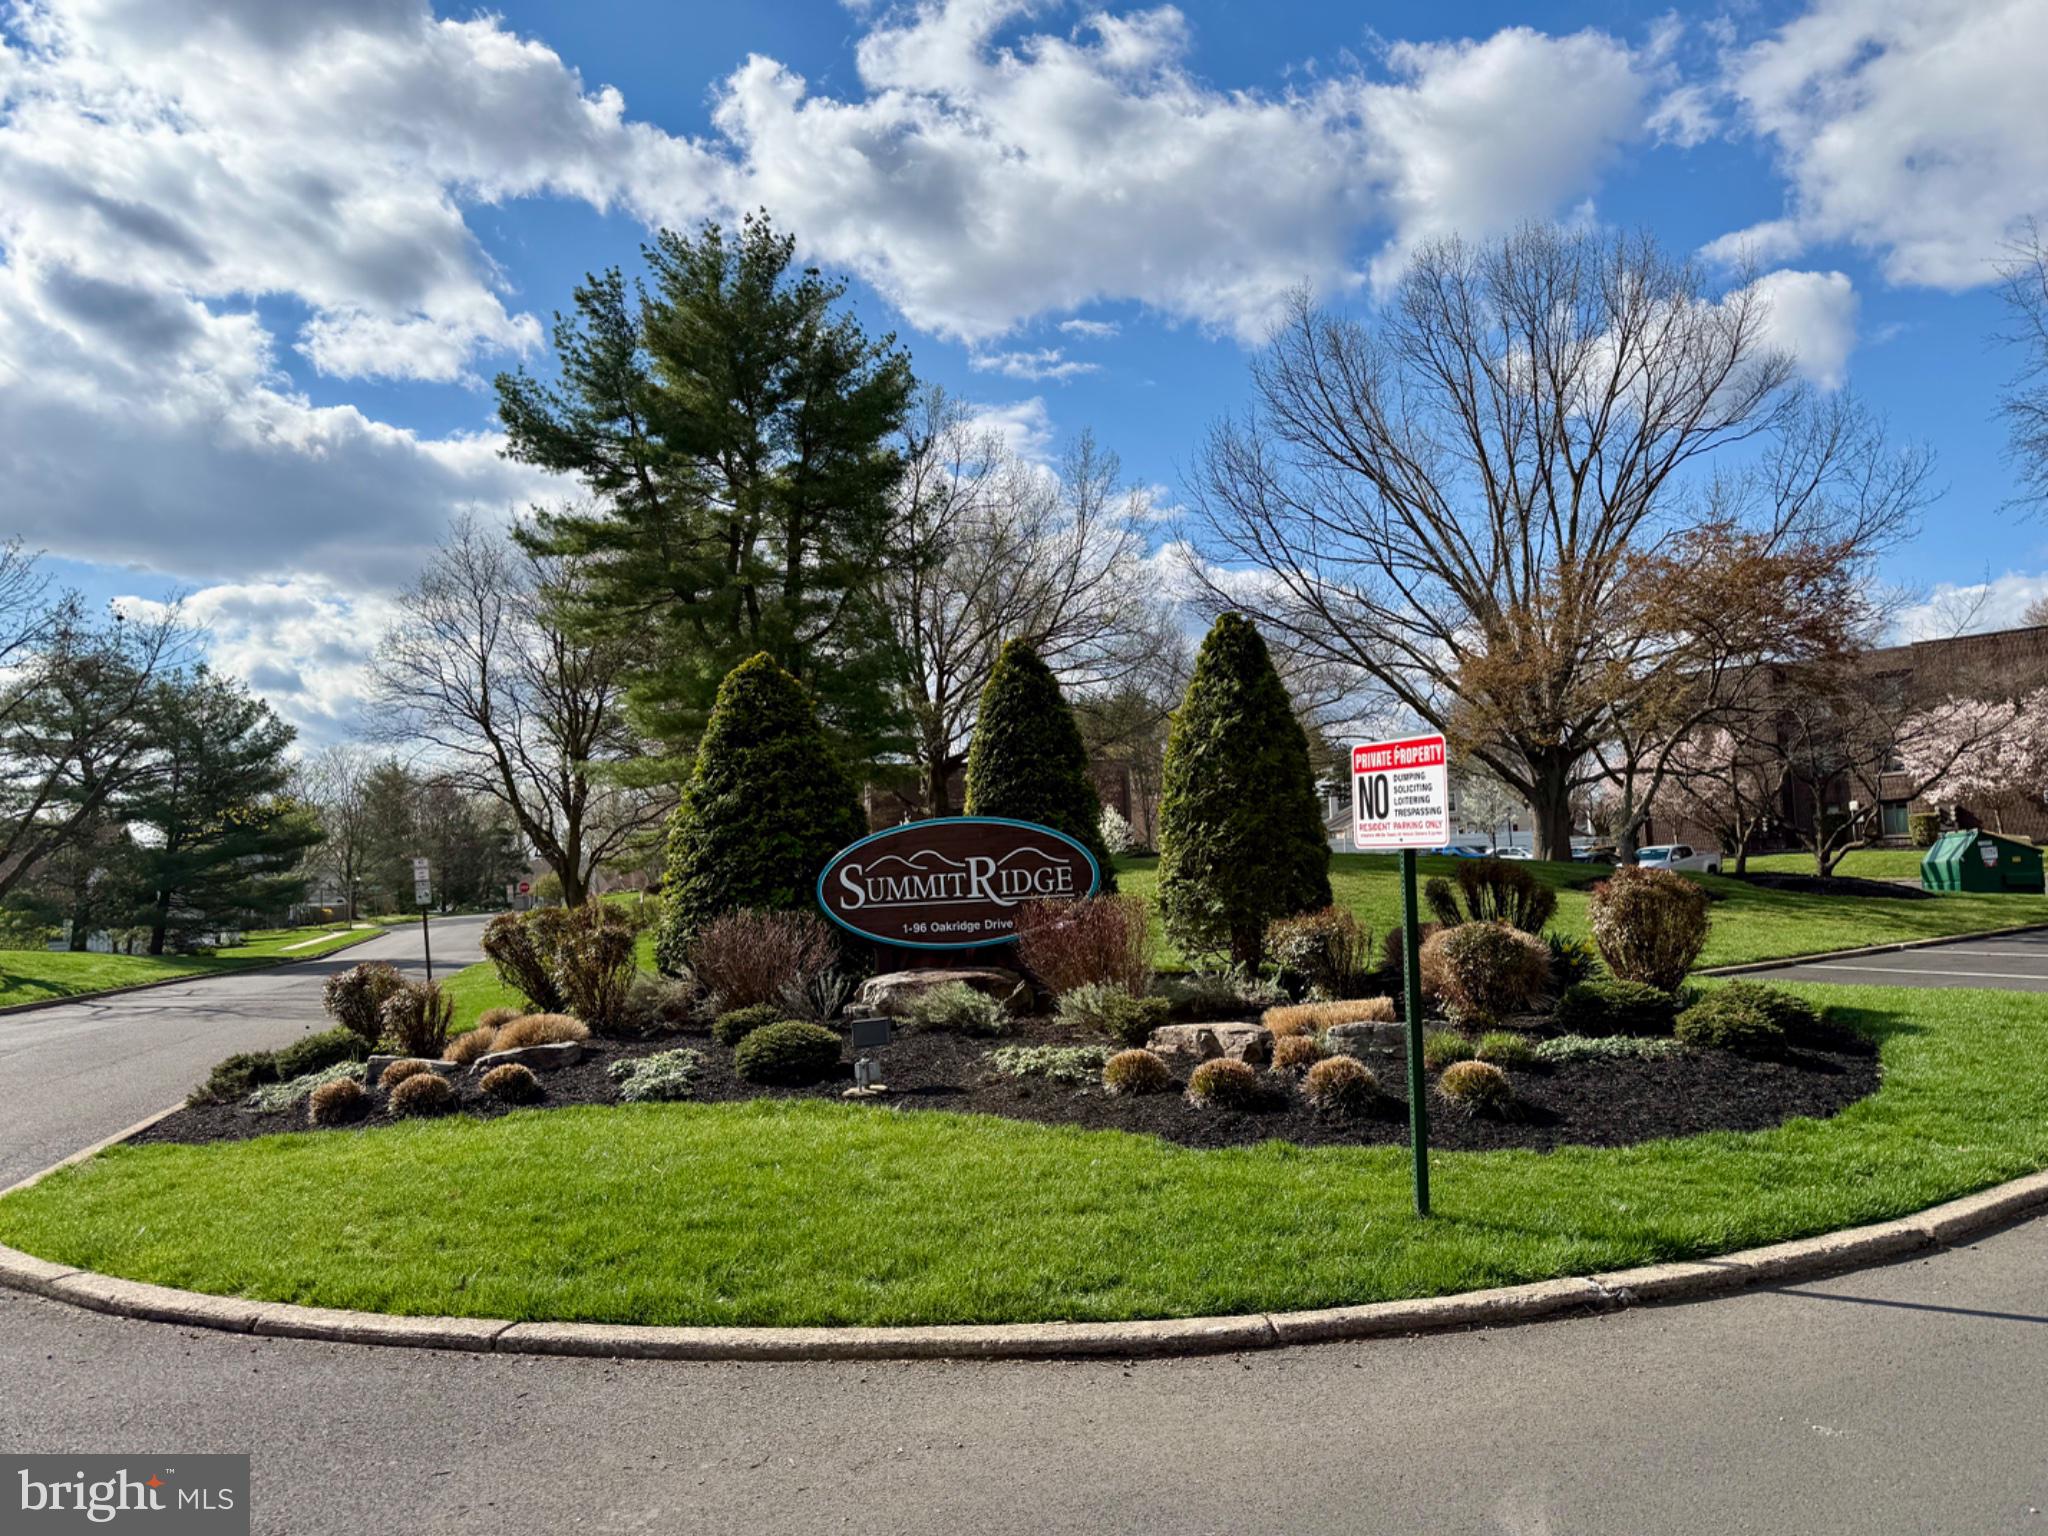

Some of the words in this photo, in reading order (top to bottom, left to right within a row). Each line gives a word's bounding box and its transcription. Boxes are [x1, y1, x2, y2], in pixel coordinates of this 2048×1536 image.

[1355, 749, 1392, 769] PRIVATE
[1394, 744, 1442, 765] PROPERTY
[1393, 771, 1426, 782] DUMPING
[1393, 783, 1433, 794] SOLICITING
[1358, 773, 1389, 820] NO
[1394, 795, 1431, 806] LOITERING
[1394, 806, 1442, 817] TRESPASSING
[1359, 822, 1392, 832] RESIDENT
[1393, 820, 1423, 830] PARKING
[1425, 819, 1443, 829] ONLY
[903, 922, 927, 934] 1-96
[930, 920, 981, 933] Oakridge
[985, 918, 1014, 931] Drive
